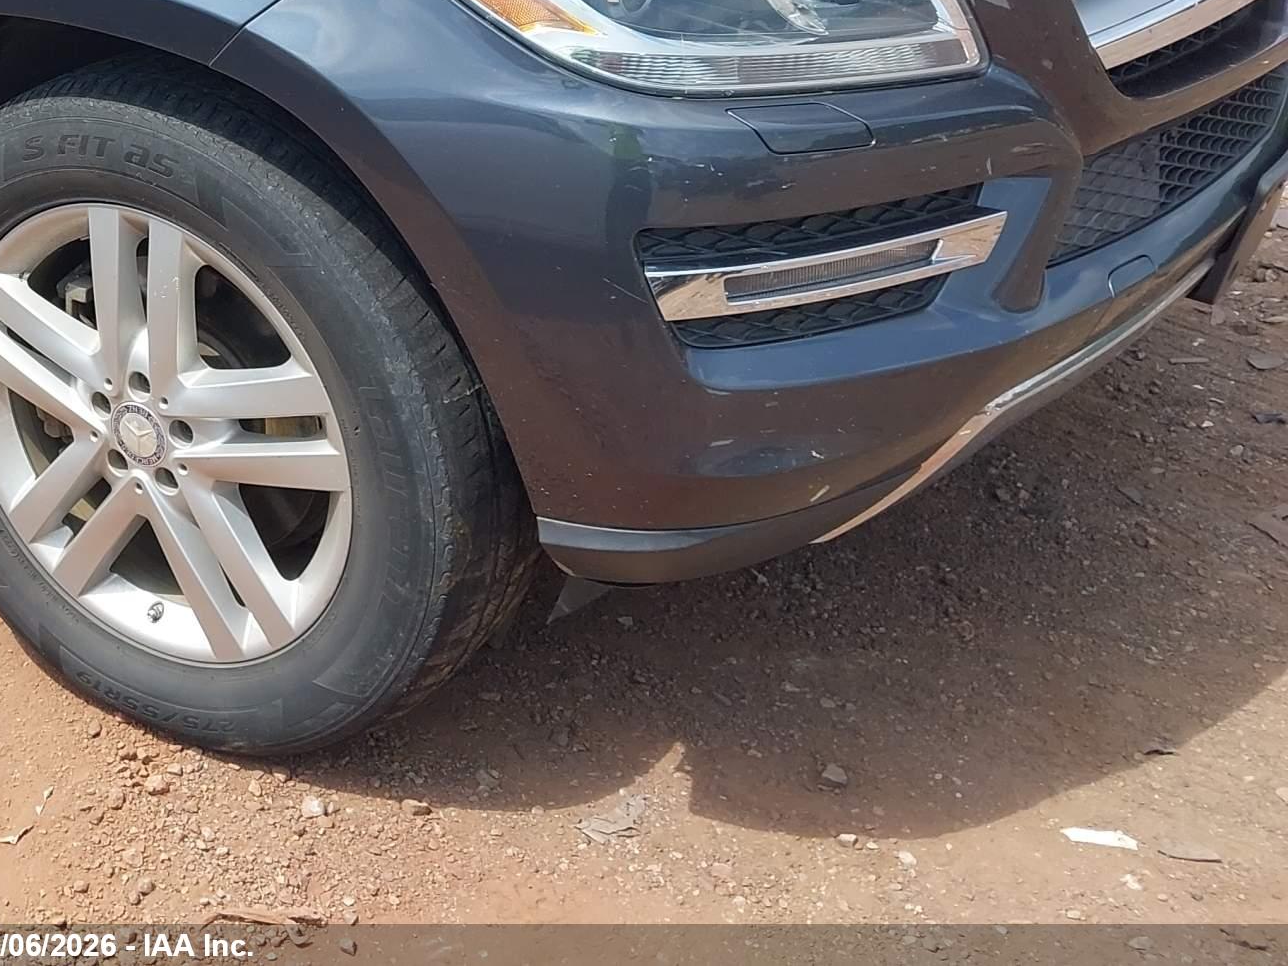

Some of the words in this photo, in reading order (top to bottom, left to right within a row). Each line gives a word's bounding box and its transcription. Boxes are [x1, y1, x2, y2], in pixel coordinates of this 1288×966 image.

[22, 135, 46, 162] S
[57, 134, 115, 158] FIT
[76, 671, 237, 733] 275/55R19
